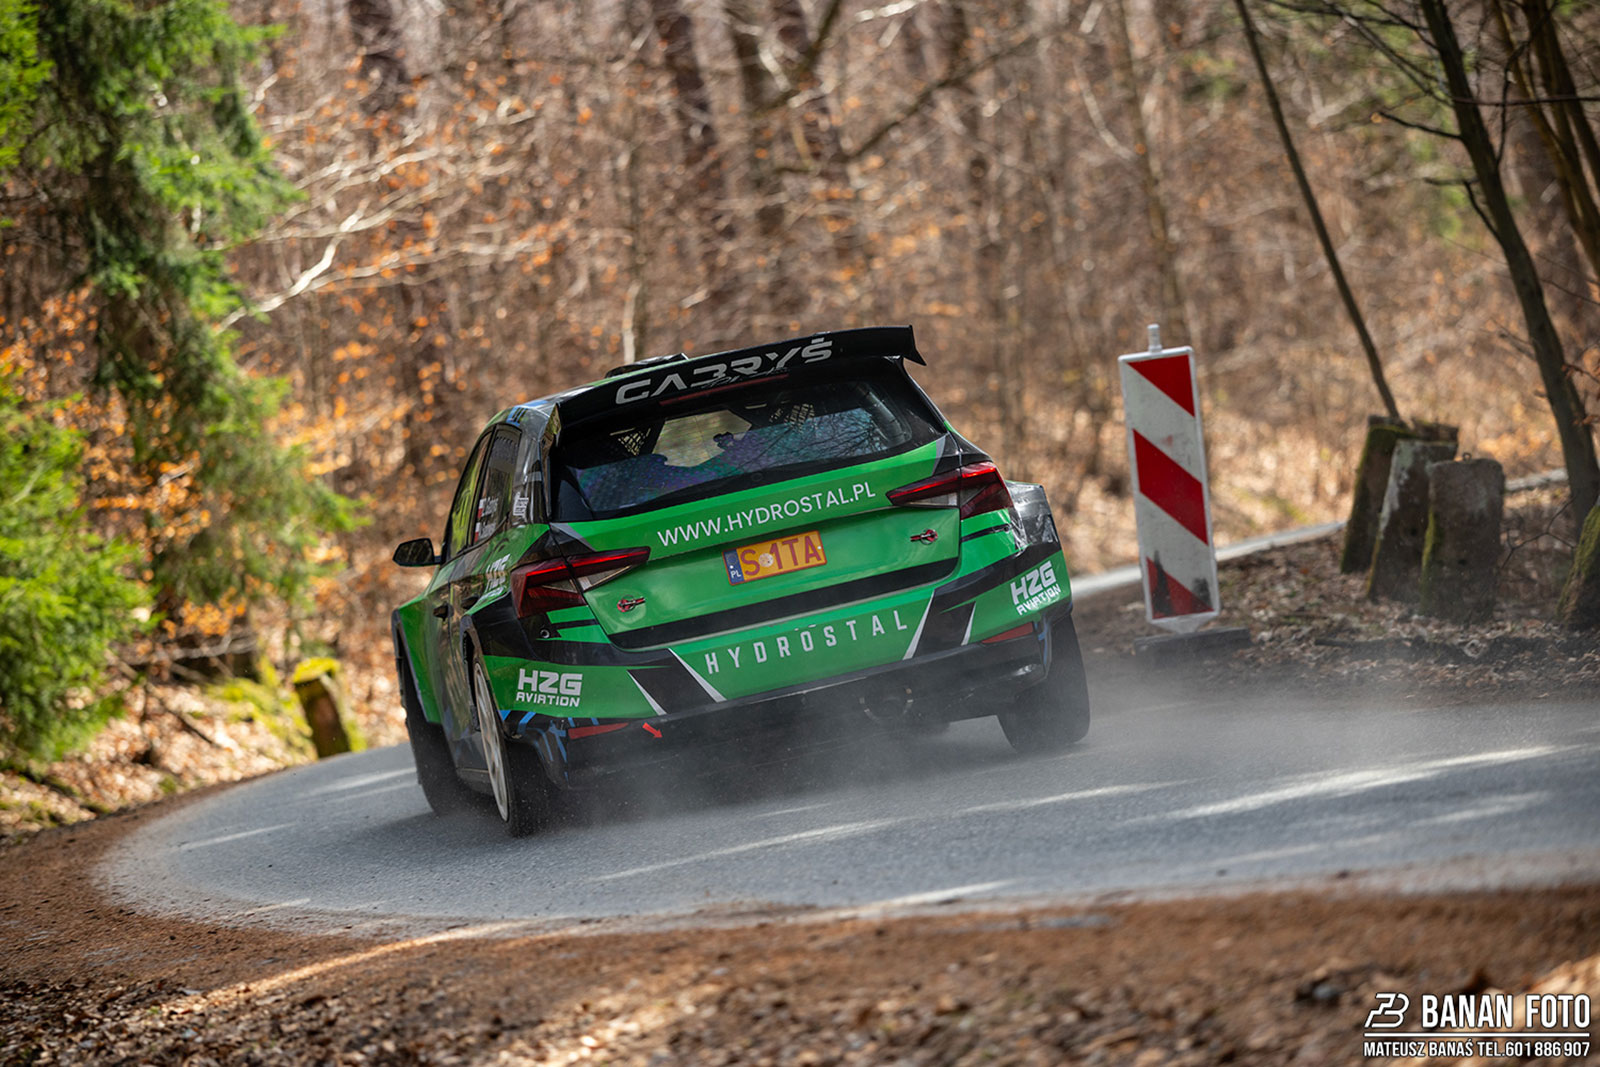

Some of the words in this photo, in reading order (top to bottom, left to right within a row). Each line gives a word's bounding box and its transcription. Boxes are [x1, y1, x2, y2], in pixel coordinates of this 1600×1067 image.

[657, 481, 876, 547] WWW.HYDROSTAL.PL
[730, 570, 742, 579] PL
[1010, 560, 1057, 605] HZG
[1016, 584, 1061, 616] AVIATION
[705, 610, 908, 675] HYDROSTAL
[518, 668, 583, 696] HZG
[515, 691, 580, 707] AVIATION
